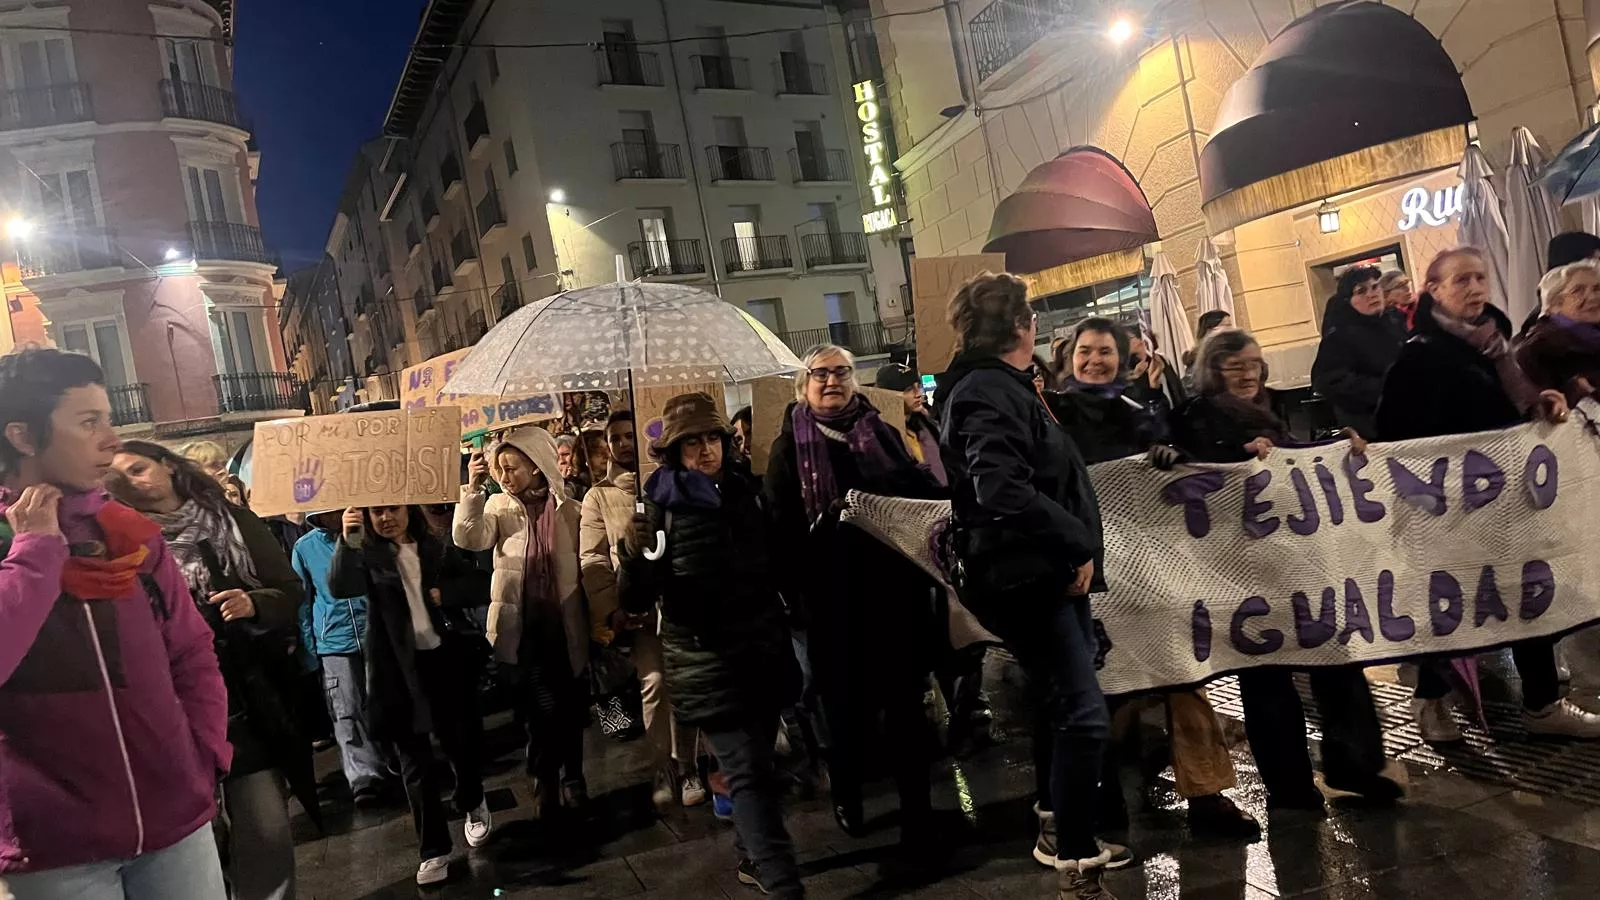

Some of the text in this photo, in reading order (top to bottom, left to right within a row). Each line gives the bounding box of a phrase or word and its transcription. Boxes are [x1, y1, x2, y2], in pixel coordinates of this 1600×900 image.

[852, 79, 891, 206] HOSTAL
[262, 422, 311, 447] POR
[356, 415, 402, 437] POR
[261, 451, 344, 503] PR
[1190, 559, 1555, 663] IGUALDAD
